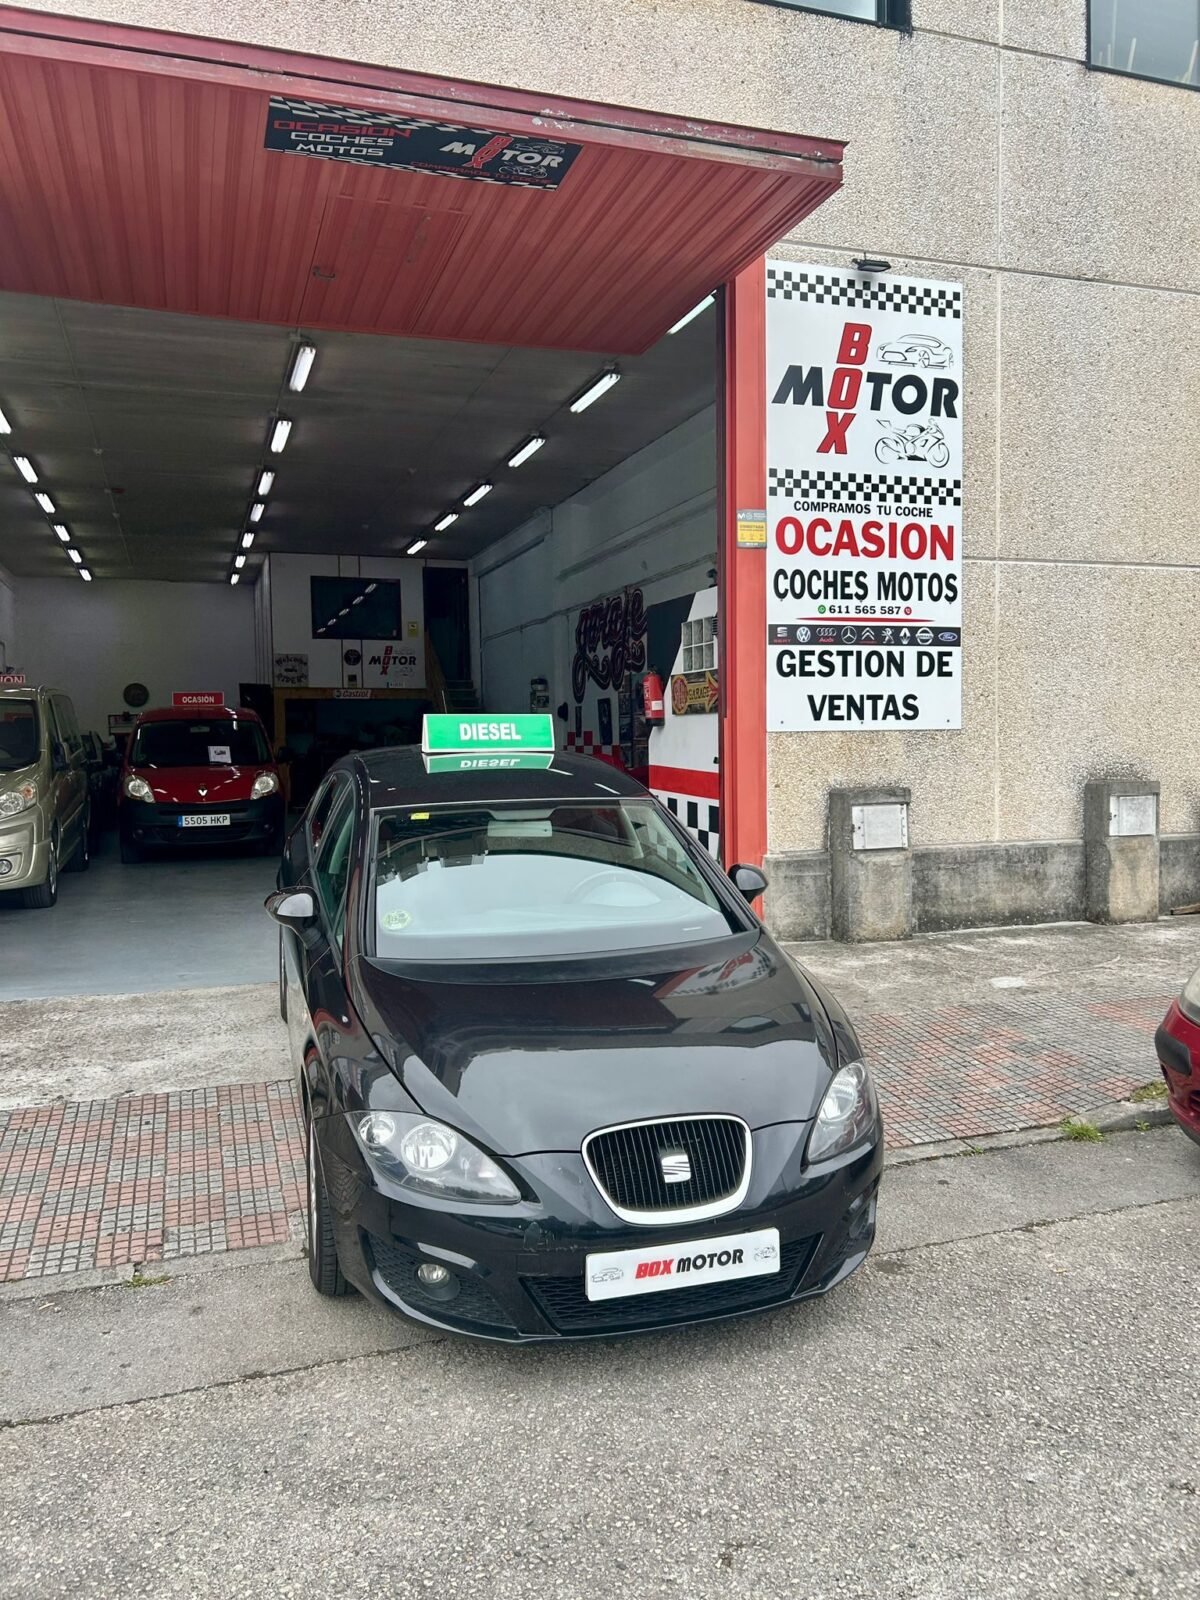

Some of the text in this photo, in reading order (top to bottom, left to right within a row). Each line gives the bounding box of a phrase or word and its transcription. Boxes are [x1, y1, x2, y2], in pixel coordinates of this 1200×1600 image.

[274, 120, 411, 139] OCASION
[290, 132, 394, 146] COCHES
[296, 143, 384, 156] MOTOS
[440, 141, 563, 168] MOTOR
[462, 135, 513, 169] BOX
[771, 365, 959, 418] MOTOR
[816, 322, 872, 454] BOX
[793, 501, 933, 518] COMPRAMOS TU COCHE
[775, 516, 954, 560] OCASION
[773, 569, 958, 603] COCHES MOTOS
[829, 604, 901, 615] 611 565 587
[368, 655, 417, 666] MOTOR
[776, 650, 953, 678] GESTION DE
[342, 690, 369, 698] Castrol
[689, 686, 710, 700] GARAGE
[807, 694, 919, 721] VENTAS
[459, 723, 522, 740] DIESEL
[184, 815, 228, 825] 5505 HKP
[635, 1249, 743, 1279] BOX MOTOR
